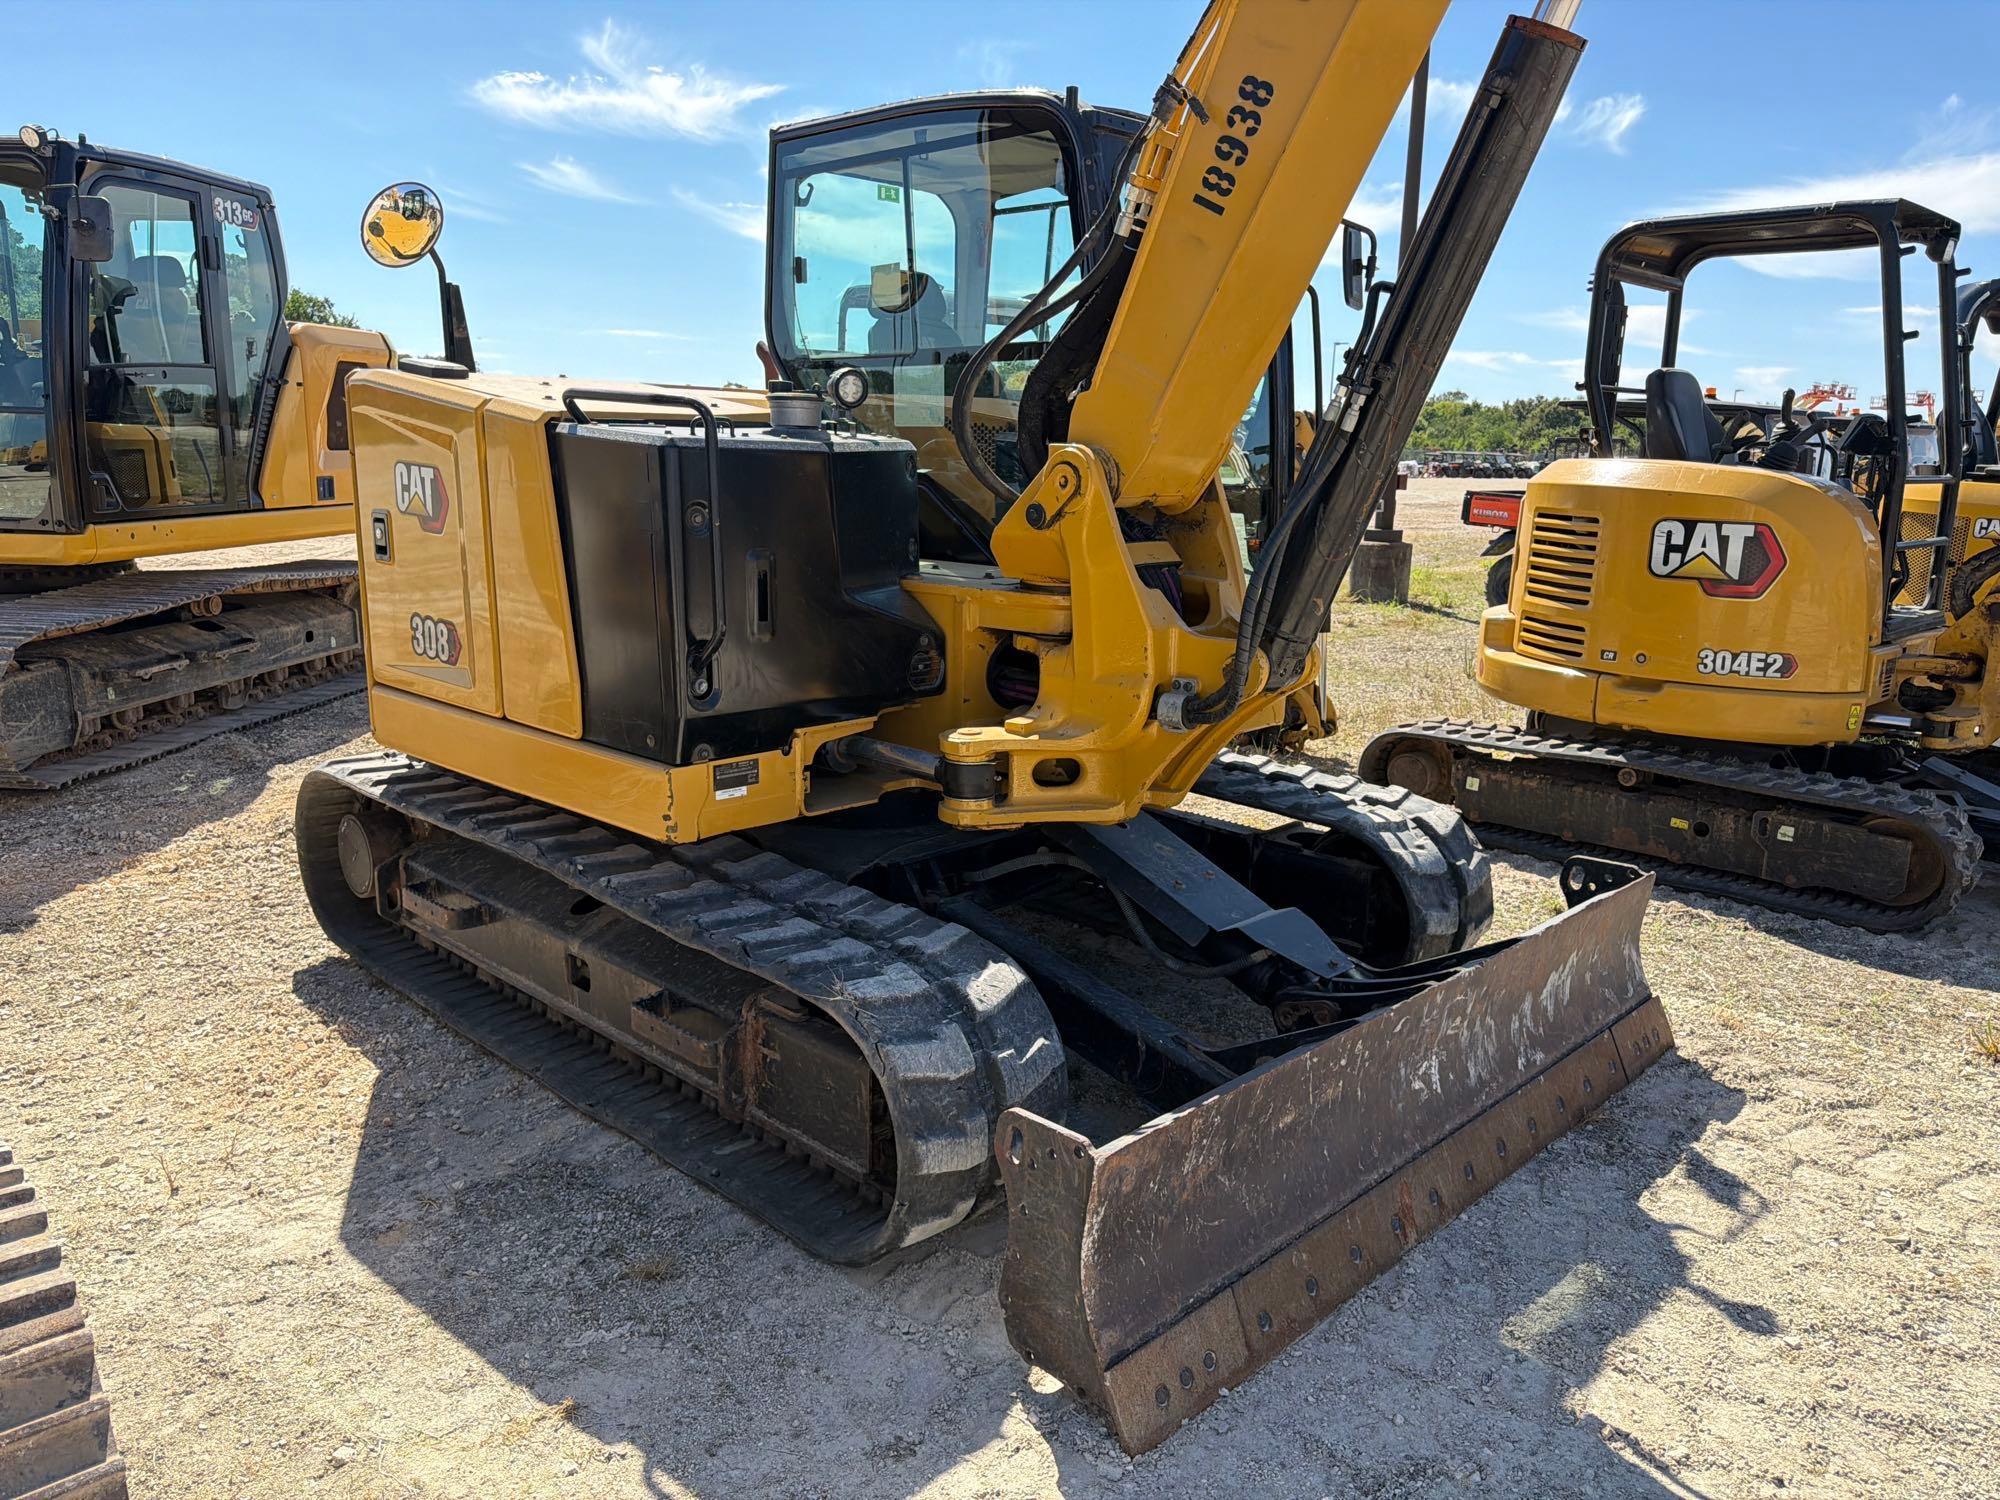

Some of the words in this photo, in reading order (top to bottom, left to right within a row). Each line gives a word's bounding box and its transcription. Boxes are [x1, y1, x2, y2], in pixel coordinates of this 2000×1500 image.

[1193, 75, 1274, 216] 18938
[214, 197, 242, 225] 313
[242, 208, 253, 223] GC
[394, 462, 435, 517] CAT
[1473, 507, 1509, 519] KUBOTA
[1973, 518, 2000, 538] CA
[1650, 519, 1756, 580] CAT
[411, 615, 449, 662] 308
[1698, 649, 1784, 678] 304E2
